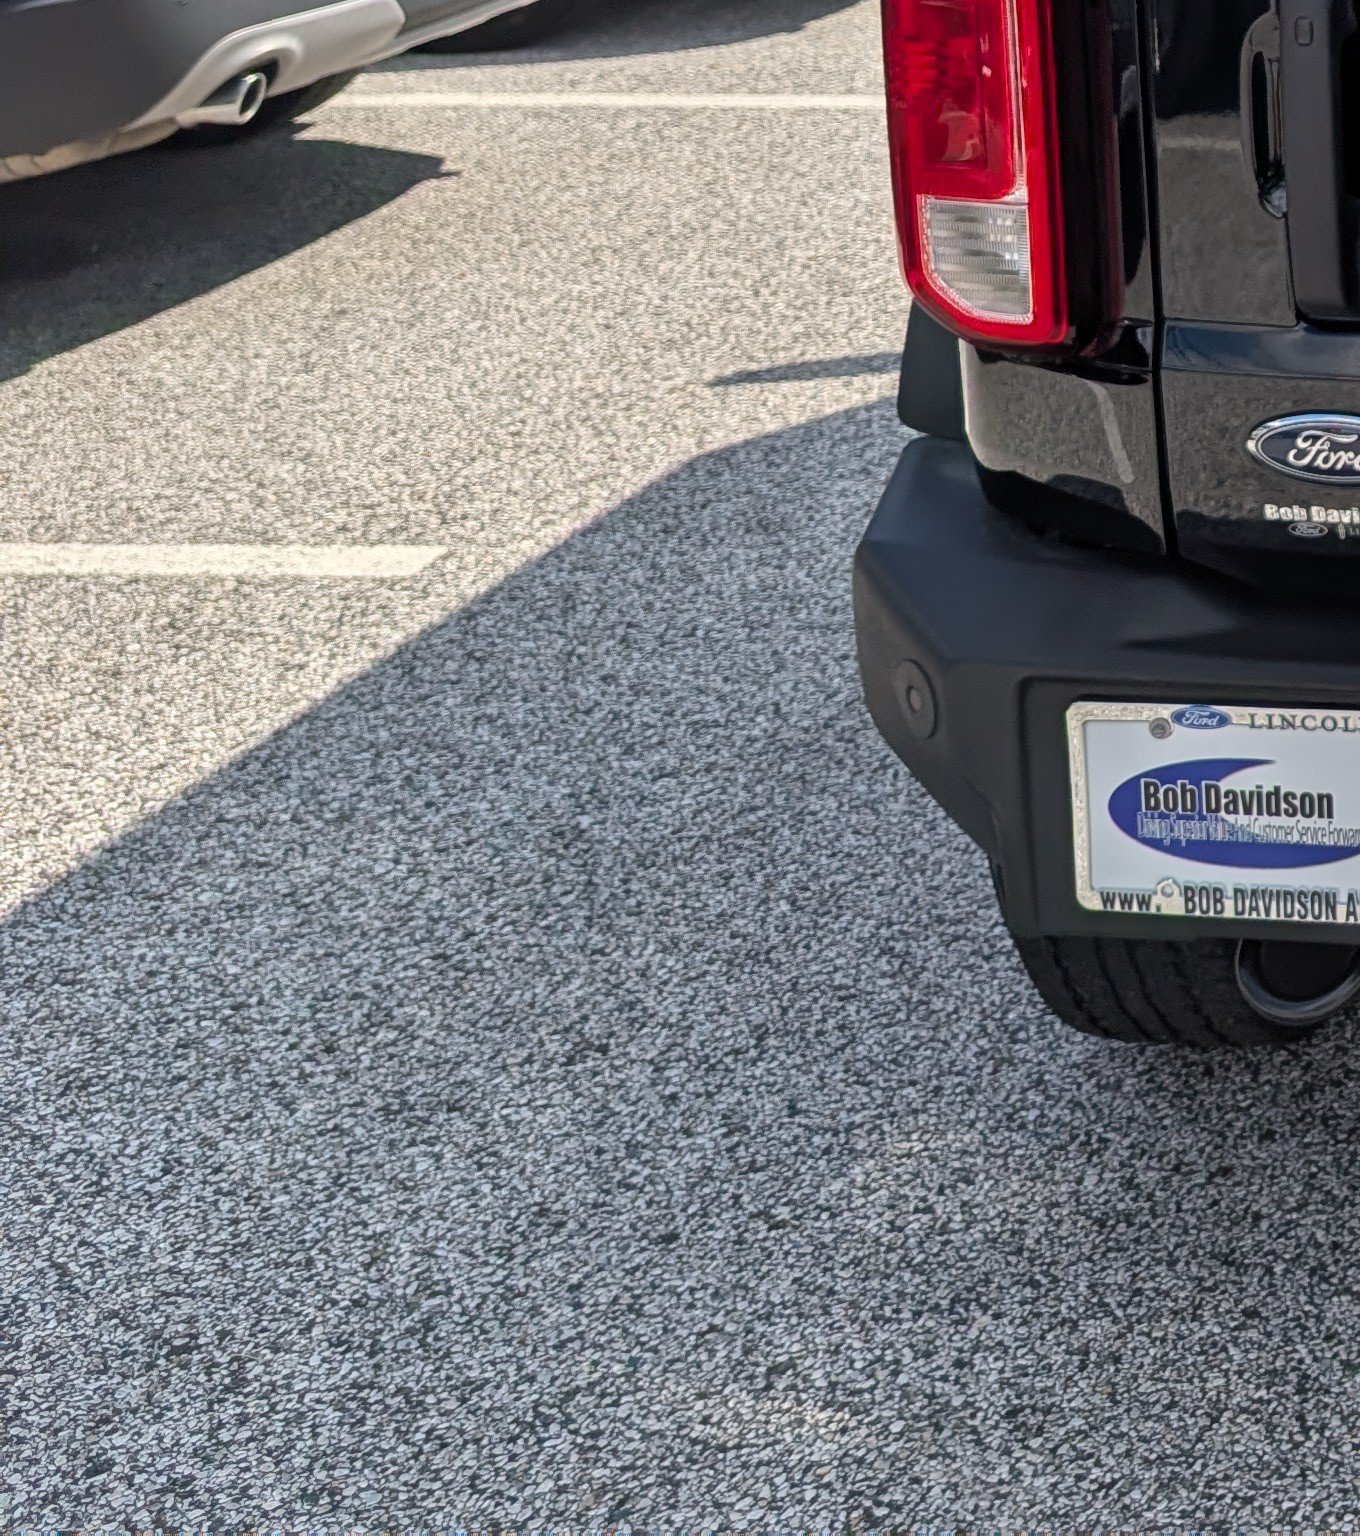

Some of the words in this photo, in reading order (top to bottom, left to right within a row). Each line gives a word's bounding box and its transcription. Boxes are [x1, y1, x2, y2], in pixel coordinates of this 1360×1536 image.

[1264, 503, 1308, 522] Bob
[1181, 710, 1220, 727] Ford
[1142, 780, 1198, 813] Bob
[1203, 781, 1335, 819] Davidson
[1138, 812, 1170, 846] Driving
[1171, 814, 1207, 846] Superior
[1253, 818, 1295, 844] Customer
[1296, 819, 1327, 845] Service
[1101, 891, 1162, 913] www.
[1184, 884, 1225, 915] BOB
[1233, 887, 1337, 921] DAVIDSON
